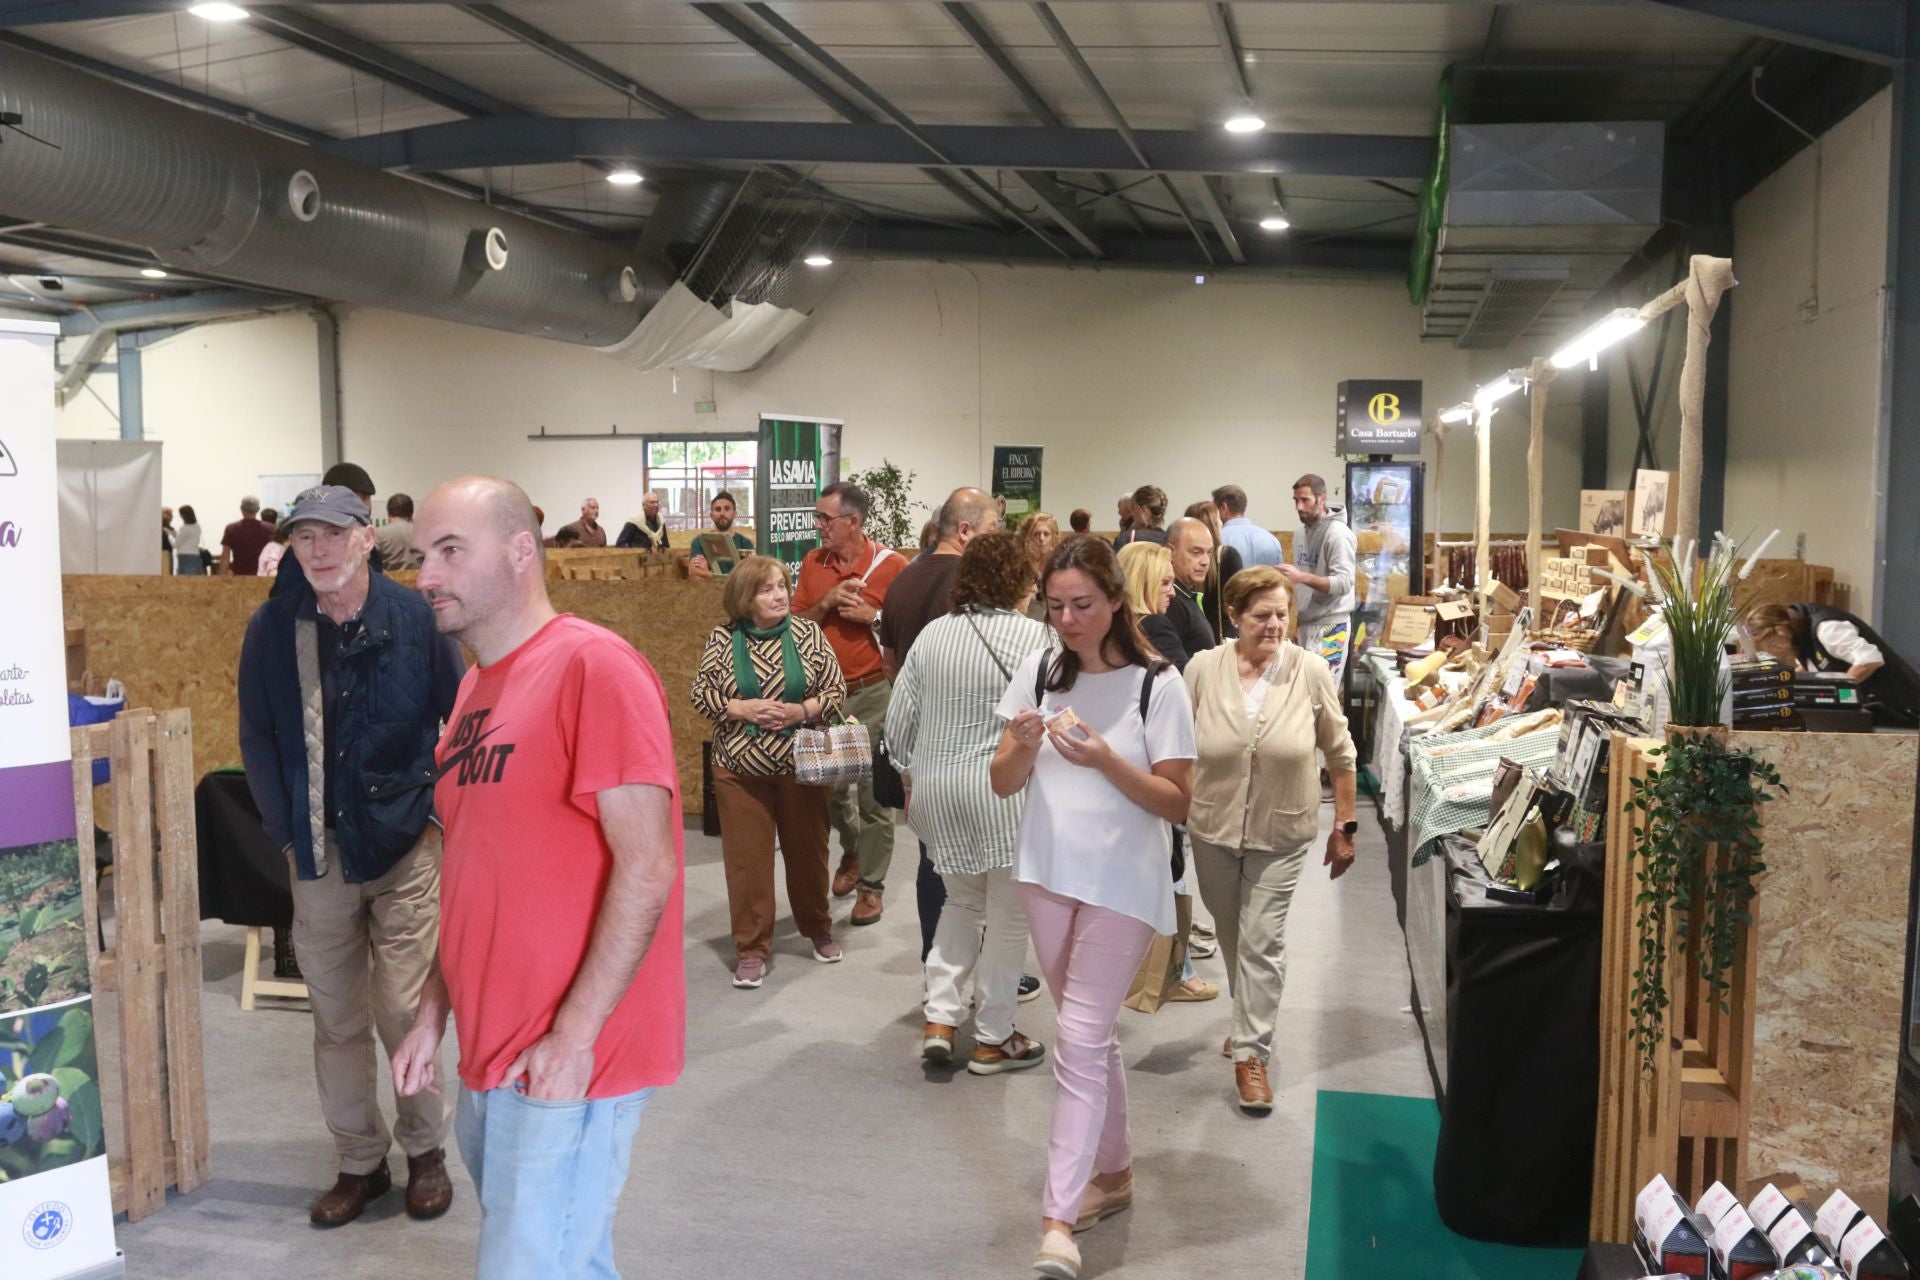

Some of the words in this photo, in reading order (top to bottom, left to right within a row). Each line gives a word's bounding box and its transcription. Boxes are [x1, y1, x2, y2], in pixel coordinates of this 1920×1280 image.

[1350, 428, 1373, 438] Casa
[1376, 428, 1417, 439] Bartuelo
[1009, 454, 1028, 465] FINCA
[769, 459, 783, 484] LA
[1002, 467, 1010, 478] EL
